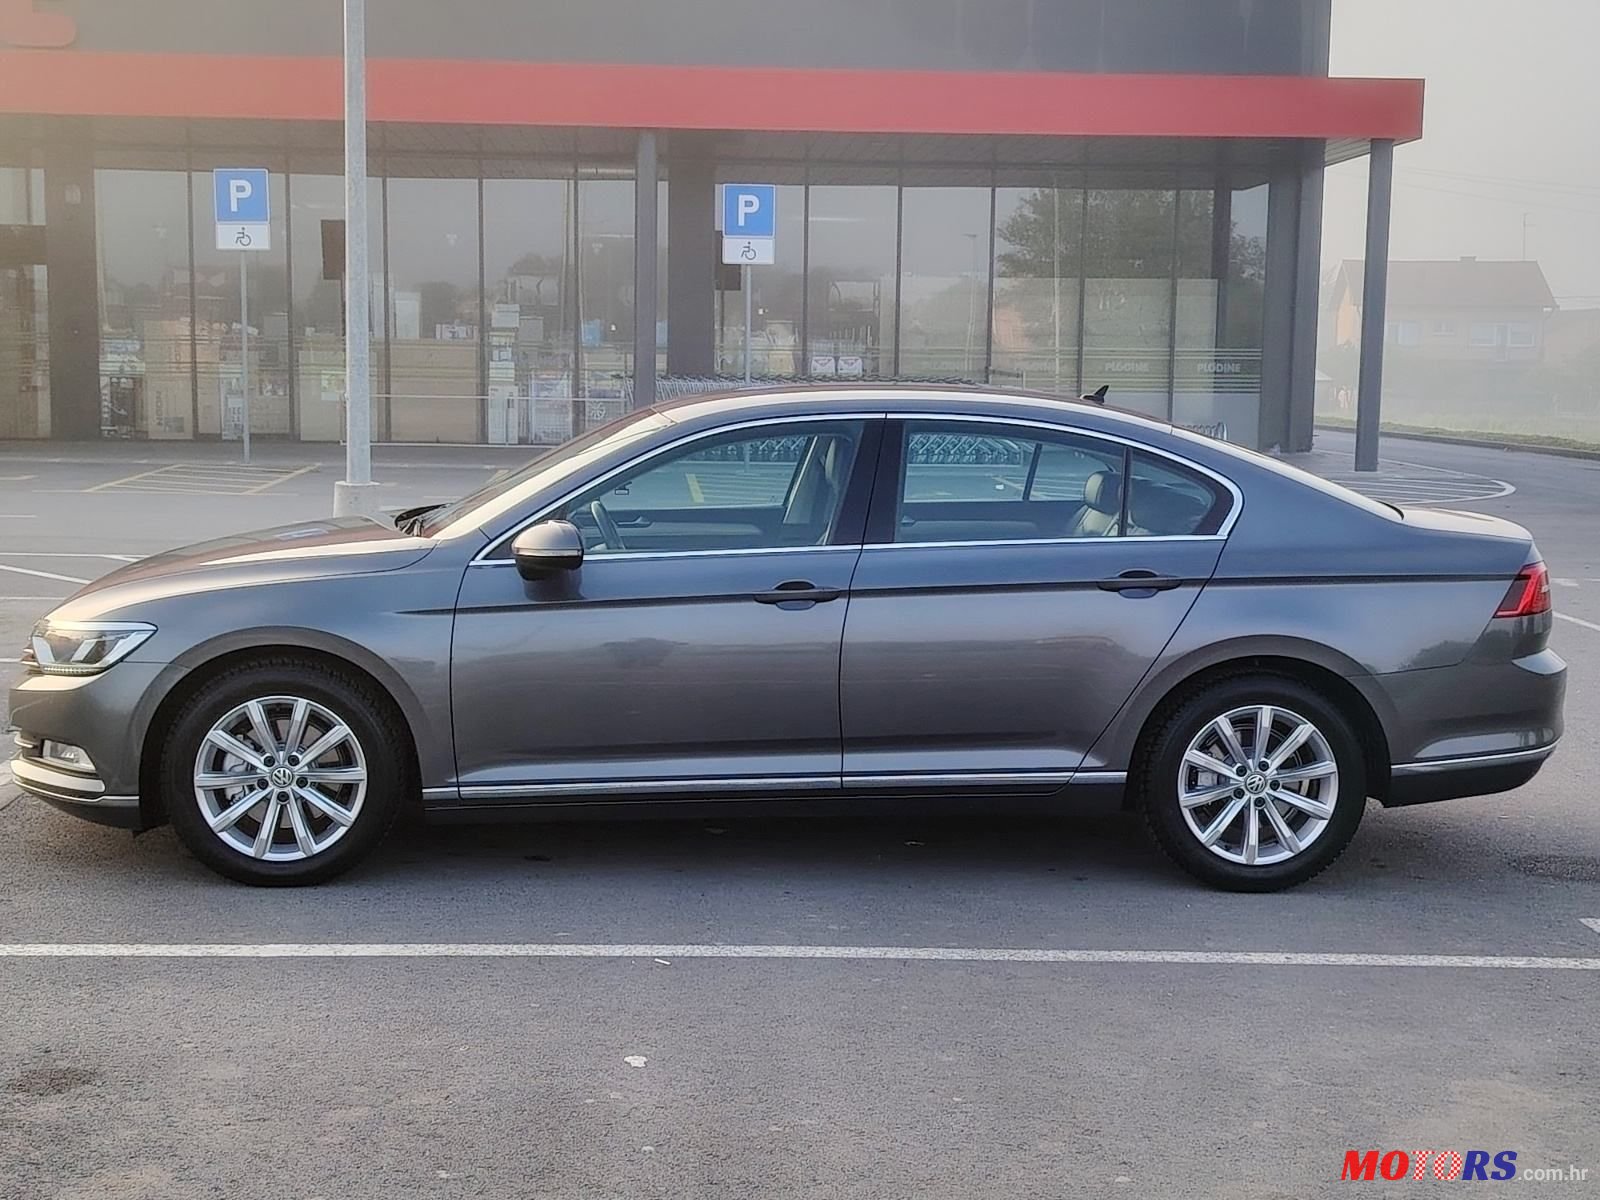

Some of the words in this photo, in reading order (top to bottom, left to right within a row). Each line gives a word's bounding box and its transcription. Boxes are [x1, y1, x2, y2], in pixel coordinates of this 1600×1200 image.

[229, 179, 252, 212] P
[738, 194, 760, 227] P
[1197, 363, 1241, 373] PLODINE
